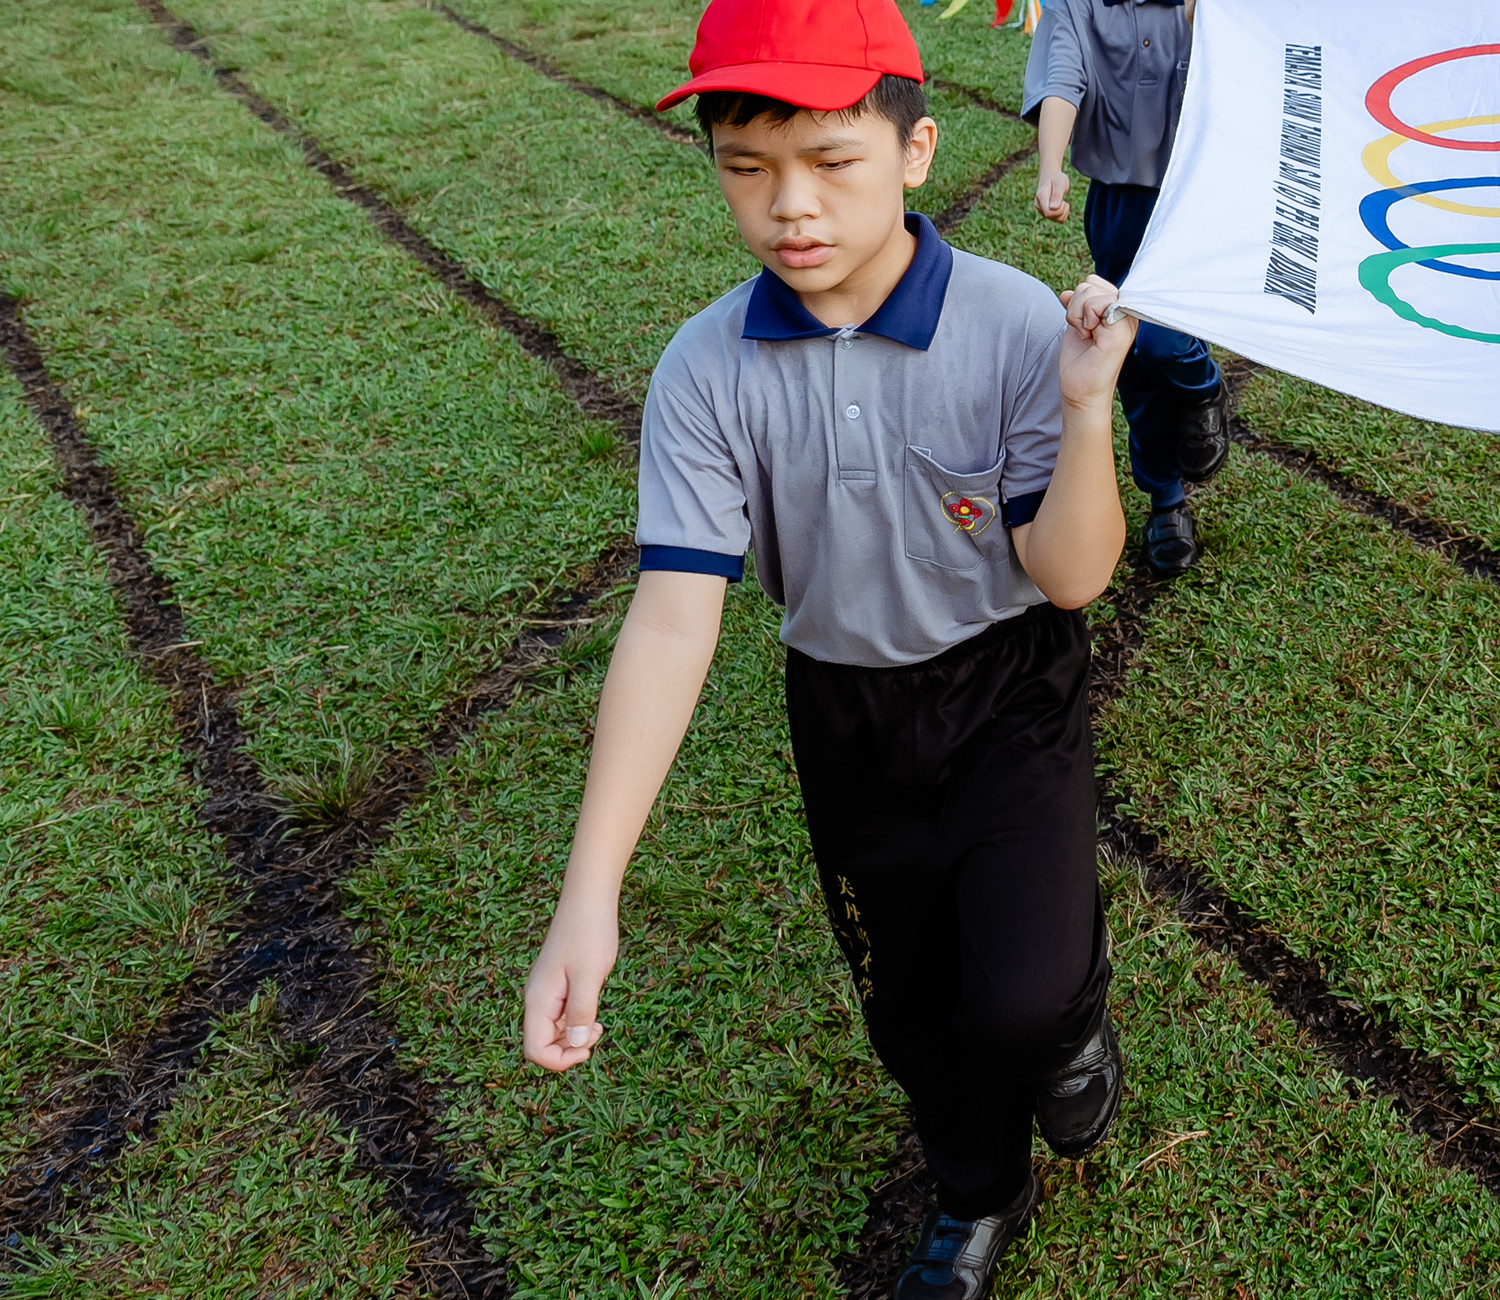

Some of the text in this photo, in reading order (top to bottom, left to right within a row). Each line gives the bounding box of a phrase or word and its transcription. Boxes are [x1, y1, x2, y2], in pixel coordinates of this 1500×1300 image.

[1284, 43, 1322, 90] TEMASYA
[1283, 88, 1322, 124] SUKAN
[1279, 118, 1322, 169] TAHUNAN
[1275, 199, 1320, 232] PEI
[1268, 220, 1319, 263] CHAI,
